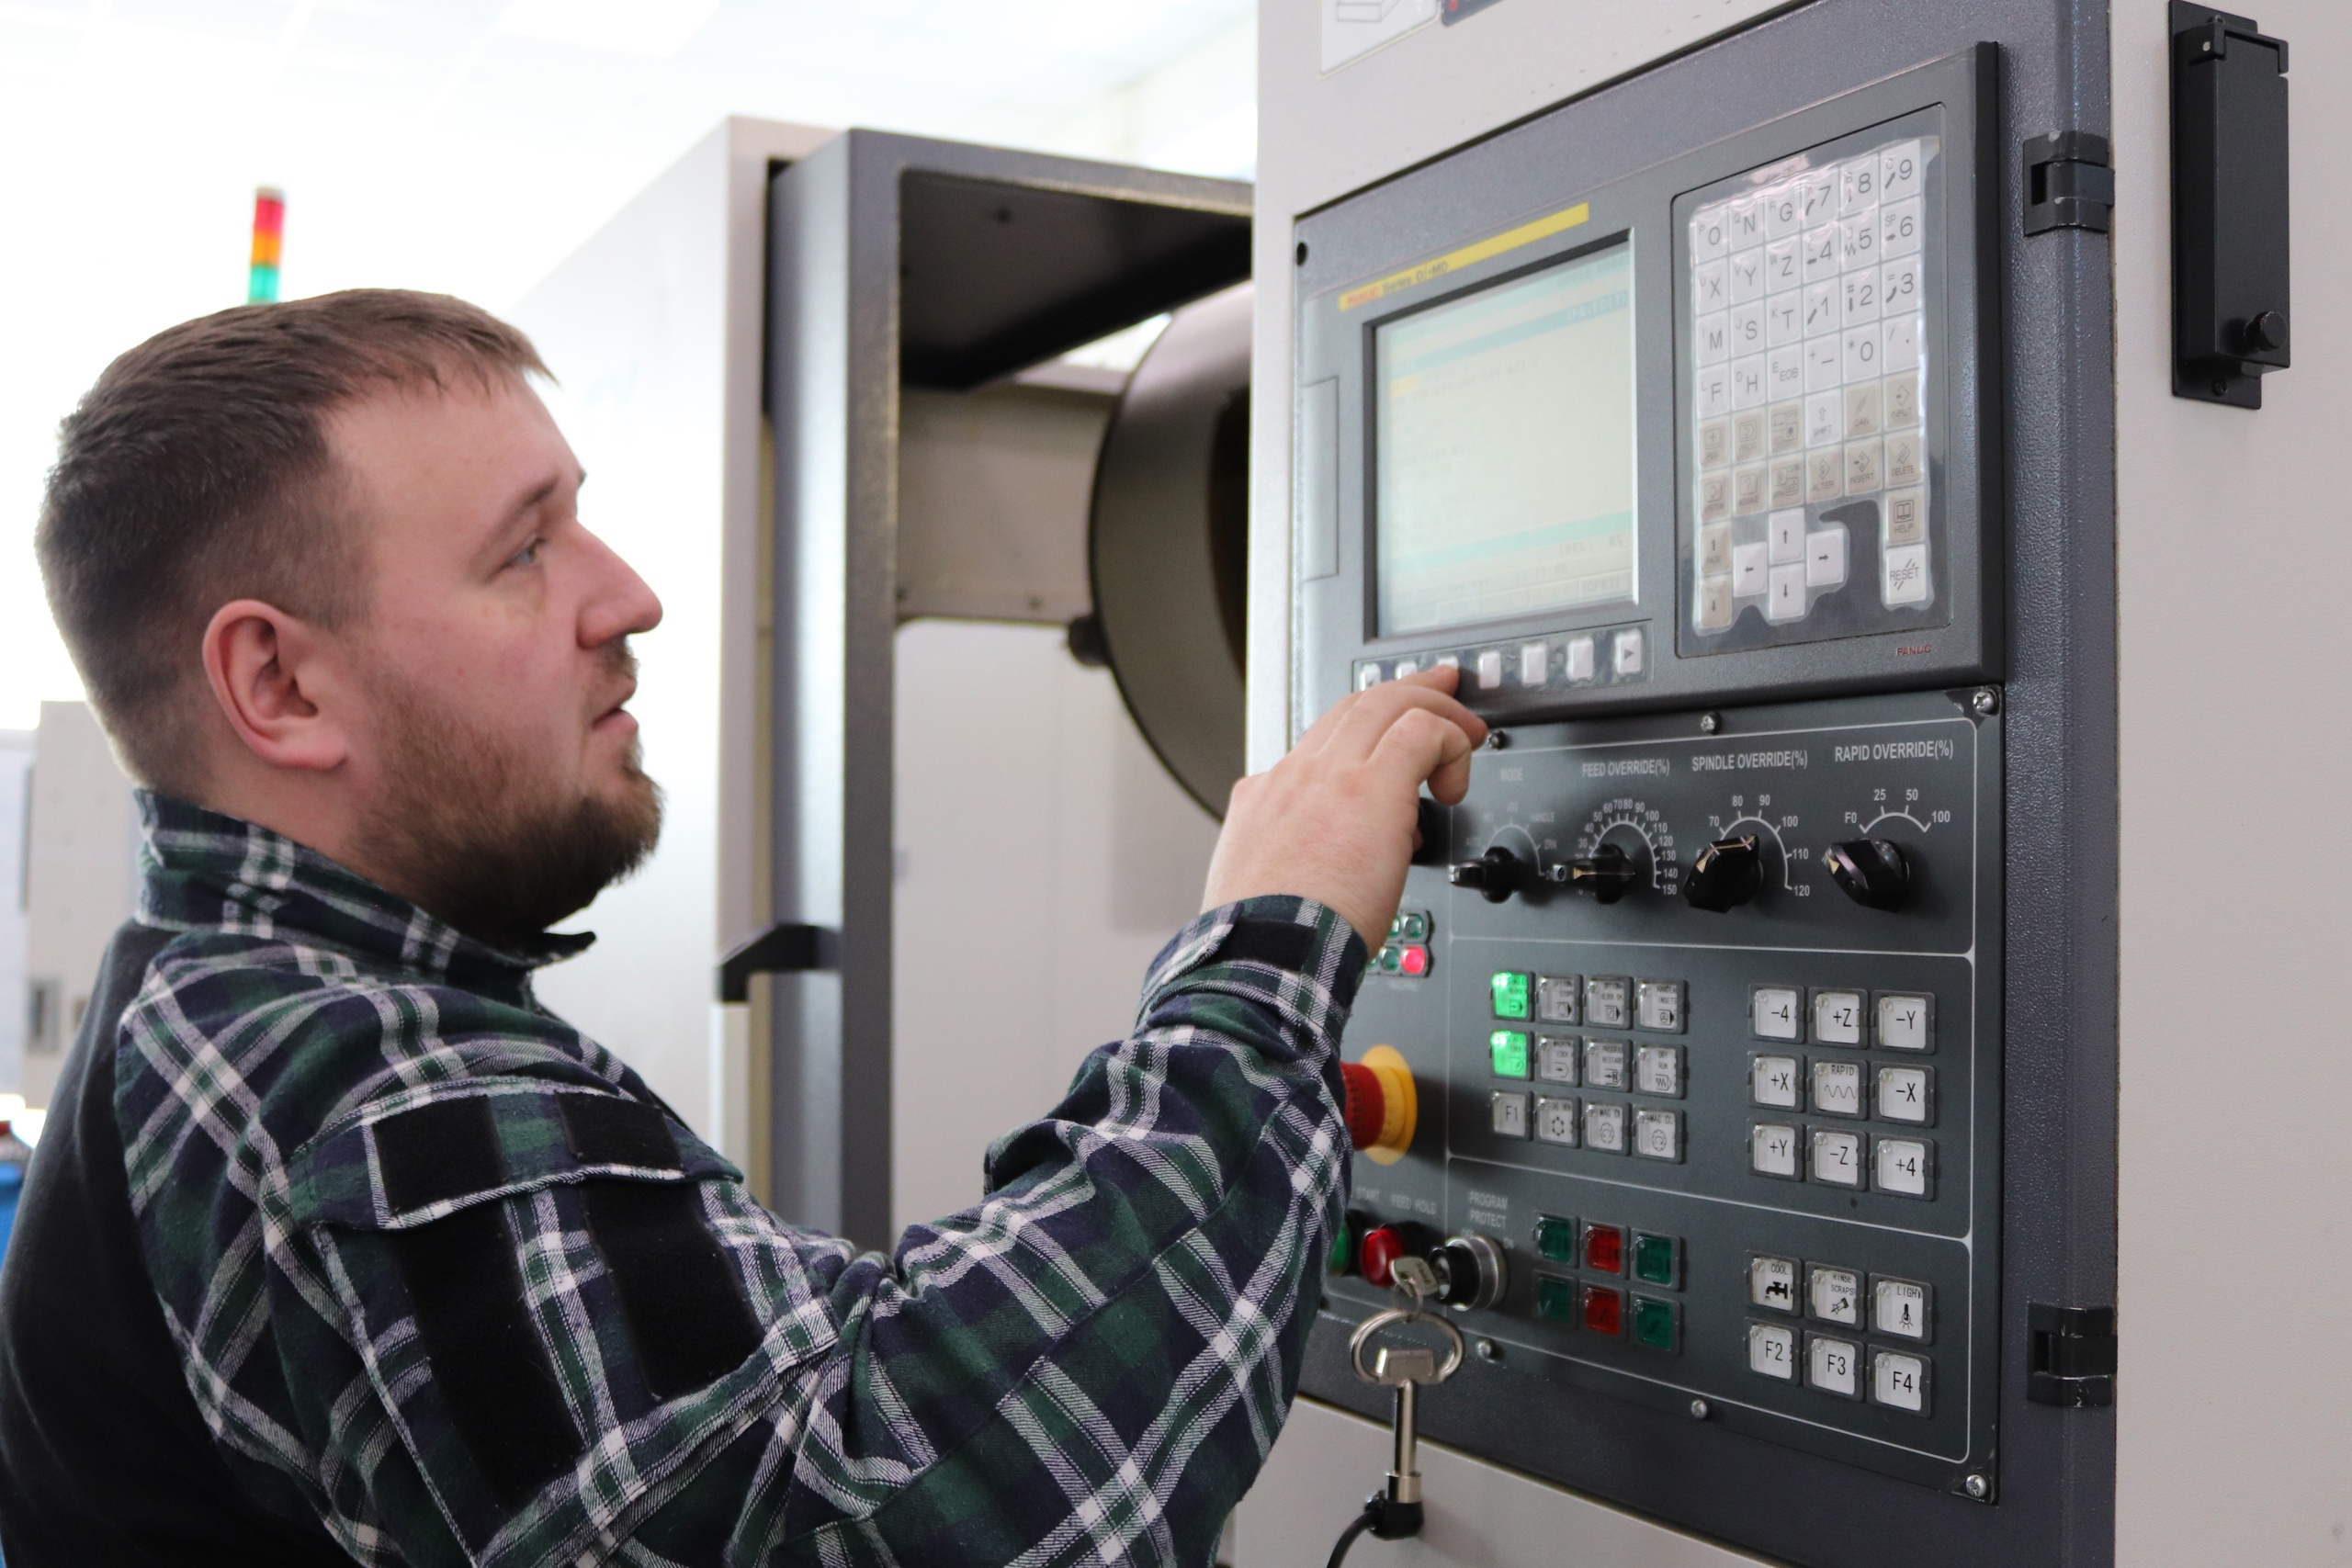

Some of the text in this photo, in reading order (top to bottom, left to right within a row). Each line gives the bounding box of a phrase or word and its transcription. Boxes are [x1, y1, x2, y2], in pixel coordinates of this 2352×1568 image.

[1899, 159, 1913, 180] 9
[1858, 172, 1871, 195] 8
[1818, 185, 1832, 208] 7
[1780, 201, 1793, 222] G
[1884, 213, 1896, 227] SP
[1744, 212, 1756, 235] N
[1899, 215, 1913, 237] 6
[1859, 227, 1872, 250] 5
[1819, 240, 1833, 261] 4
[1781, 254, 1793, 276] Z
[1745, 266, 1757, 287] Y
[1901, 273, 1914, 294] 3
[1710, 276, 1722, 299] X
[1860, 285, 1872, 306] 2
[1822, 297, 1828, 316] 1
[1781, 309, 1794, 330] T
[1710, 328, 1723, 350] M
[1746, 320, 1758, 341] S
[1780, 367, 1798, 381] EOB
[1710, 381, 1722, 402] F
[1747, 373, 1758, 394] H
[1849, 473, 1875, 484] INSERT
[1892, 465, 1915, 477] DELETE
[1813, 480, 1834, 491] ALTER
[1894, 524, 1914, 534] HELP
[1890, 566, 1920, 581] RESET
[1896, 645, 1931, 656] FANUC
[1835, 739, 1954, 762] RAPID OVERRIDE(%)
[1582, 759, 1670, 778] FEED OVERRIDE(%)
[1692, 750, 1808, 772] SPINDLE OVERRIDE(%)
[1613, 799, 1623, 809] 70
[1623, 799, 1633, 809] 80
[1732, 795, 1743, 807] 80
[1759, 795, 1770, 806] 90
[1873, 789, 1886, 801] 25
[1905, 789, 1918, 801] 50
[1603, 803, 1613, 813] 60
[1635, 802, 1645, 813] 90
[1645, 811, 1660, 821] 100
[1932, 810, 1951, 823] 100
[1593, 812, 1603, 822] 50
[1709, 816, 1720, 827] 70
[1782, 816, 1798, 827] 100
[1845, 812, 1858, 824] F0
[1584, 823, 1594, 833] 40
[1653, 823, 1668, 833] 110
[1578, 838, 1589, 848] 30
[1658, 836, 1673, 847] 120
[1661, 851, 1677, 861] 130
[1792, 848, 1809, 860] 110
[1664, 868, 1679, 878] 140
[1662, 885, 1678, 895] 150
[1793, 885, 1810, 897] 120
[1771, 1004, 1790, 1022] -4
[1833, 1009, 1851, 1027] +Z
[1896, 1010, 1916, 1030] -Y
[1831, 1065, 1854, 1077] RAPID
[1771, 1072, 1789, 1090] +X
[1896, 1082, 1916, 1102] -X
[1506, 1105, 1519, 1122] F1
[1770, 1139, 1788, 1157] +Y
[1830, 1146, 1849, 1165] -Z
[1896, 1157, 1917, 1176] +4
[1391, 1194, 1437, 1215] FEED HOLD
[1470, 1190, 1508, 1211] PROGRAM
[1470, 1210, 1506, 1228] PROTECT
[1771, 1263, 1788, 1275] COOL
[1766, 1340, 1783, 1361] F2
[1827, 1354, 1847, 1376] F3
[1893, 1371, 1913, 1393] F4
